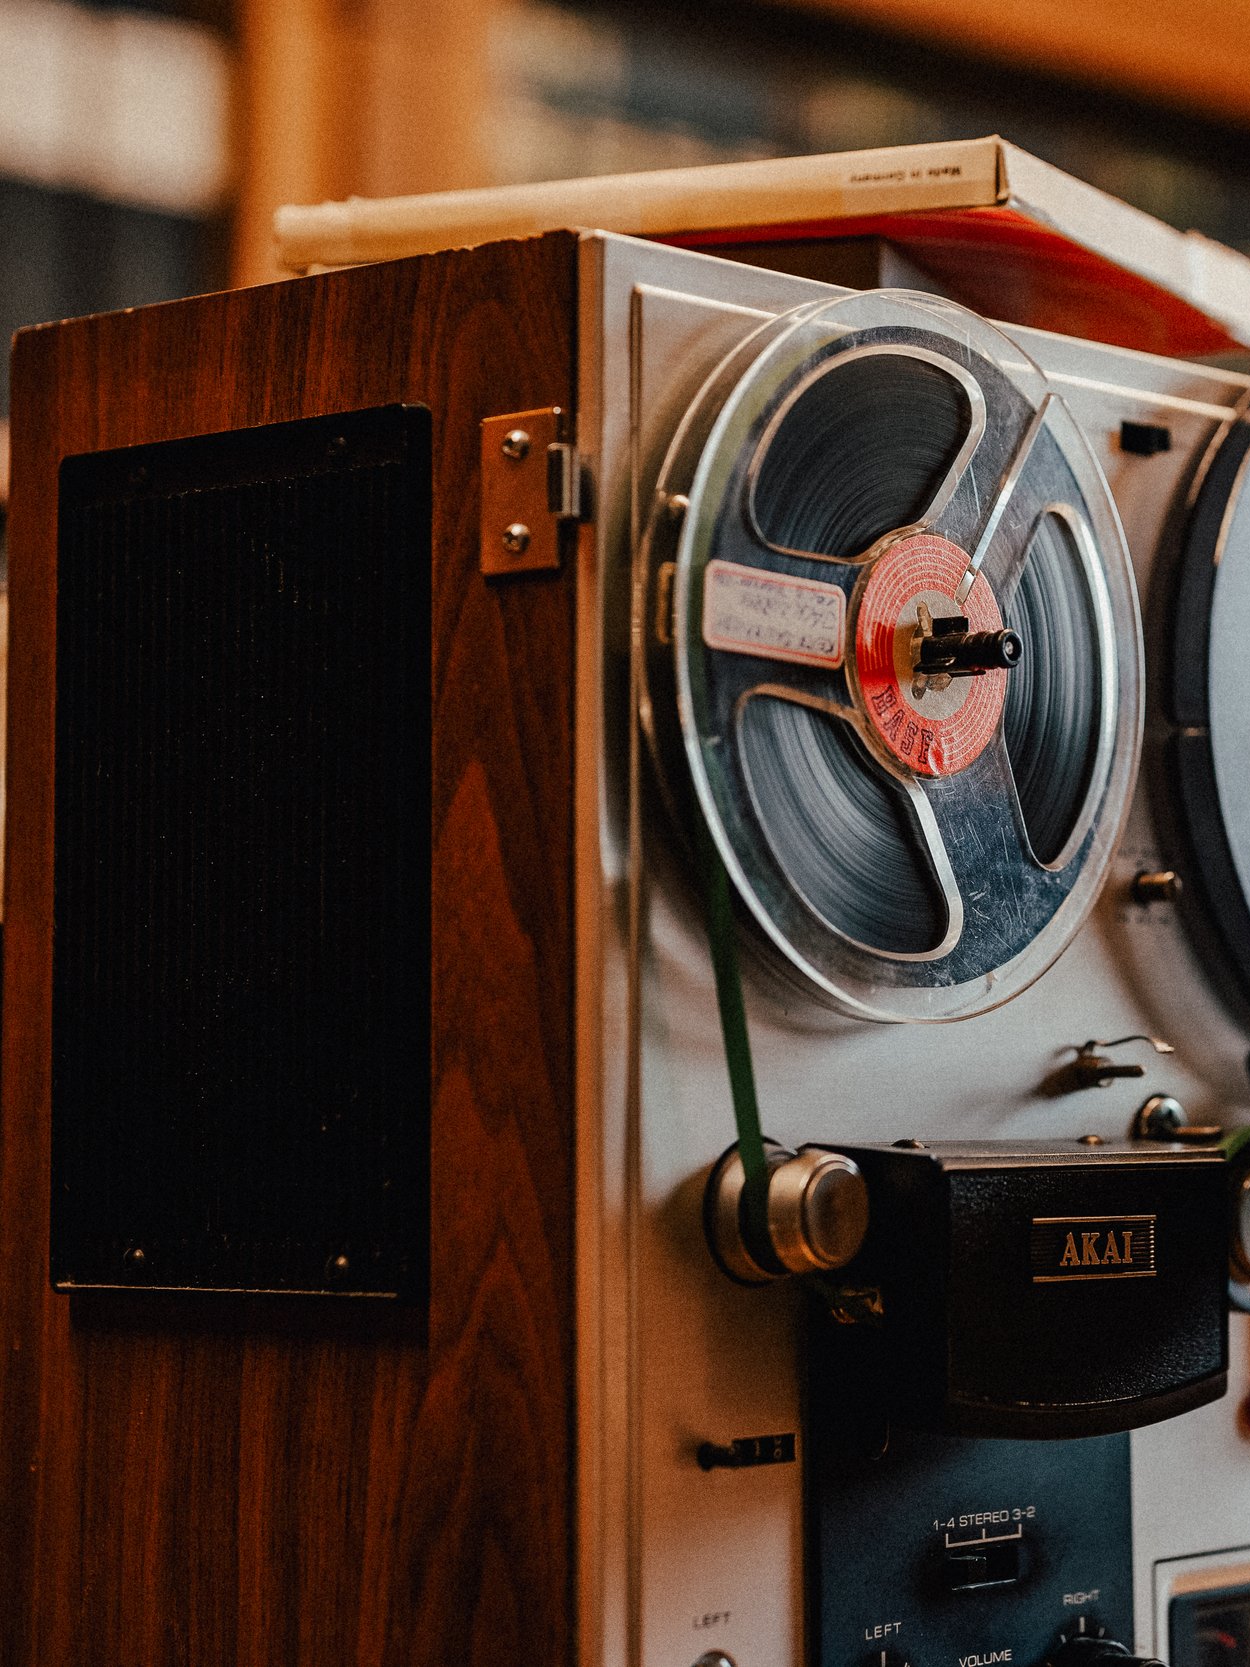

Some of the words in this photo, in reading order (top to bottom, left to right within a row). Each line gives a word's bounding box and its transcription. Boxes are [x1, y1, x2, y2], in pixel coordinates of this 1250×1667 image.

[871, 684, 934, 765] BASF
[1059, 1230, 1133, 1267] AKAI
[932, 1516, 956, 1531] 1-4
[959, 1509, 1010, 1527] STEREO
[1011, 1505, 1037, 1521] 3-2
[1062, 1588, 1100, 1606] RIGHT
[691, 1611, 731, 1631] LEFT
[865, 1621, 902, 1641] LEFT
[958, 1649, 1013, 1667] VOLUME
